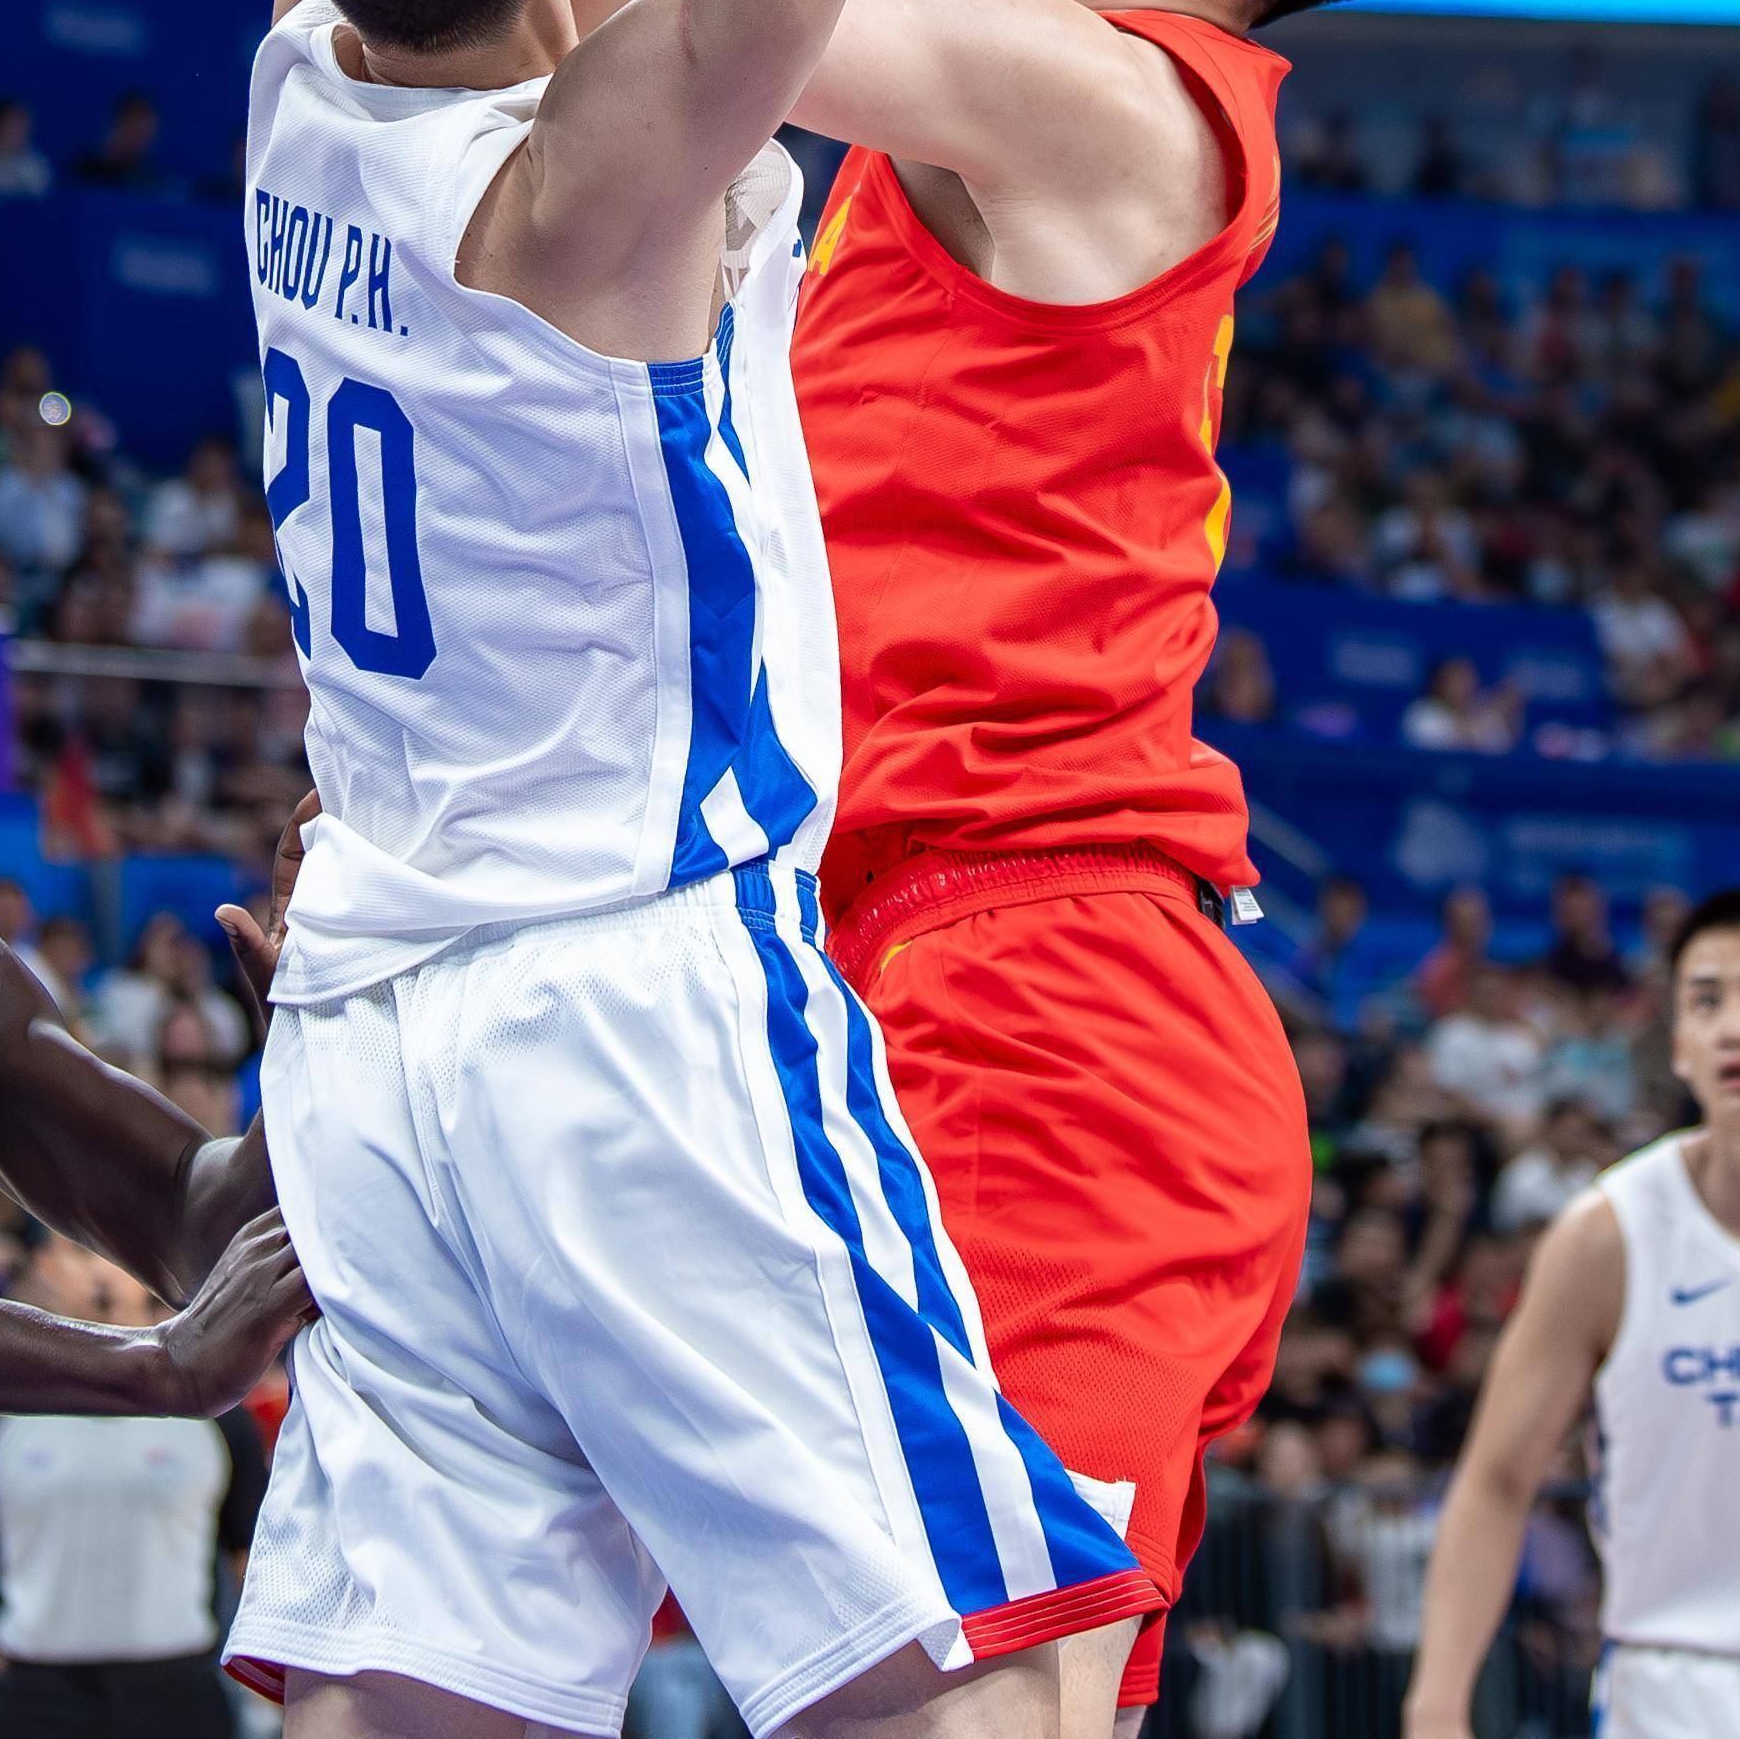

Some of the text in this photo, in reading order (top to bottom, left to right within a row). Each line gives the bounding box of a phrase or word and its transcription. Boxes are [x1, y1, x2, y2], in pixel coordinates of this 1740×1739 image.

[256, 188, 333, 310] CHOU
[334, 224, 409, 337] P.H.
[263, 346, 438, 680] 20
